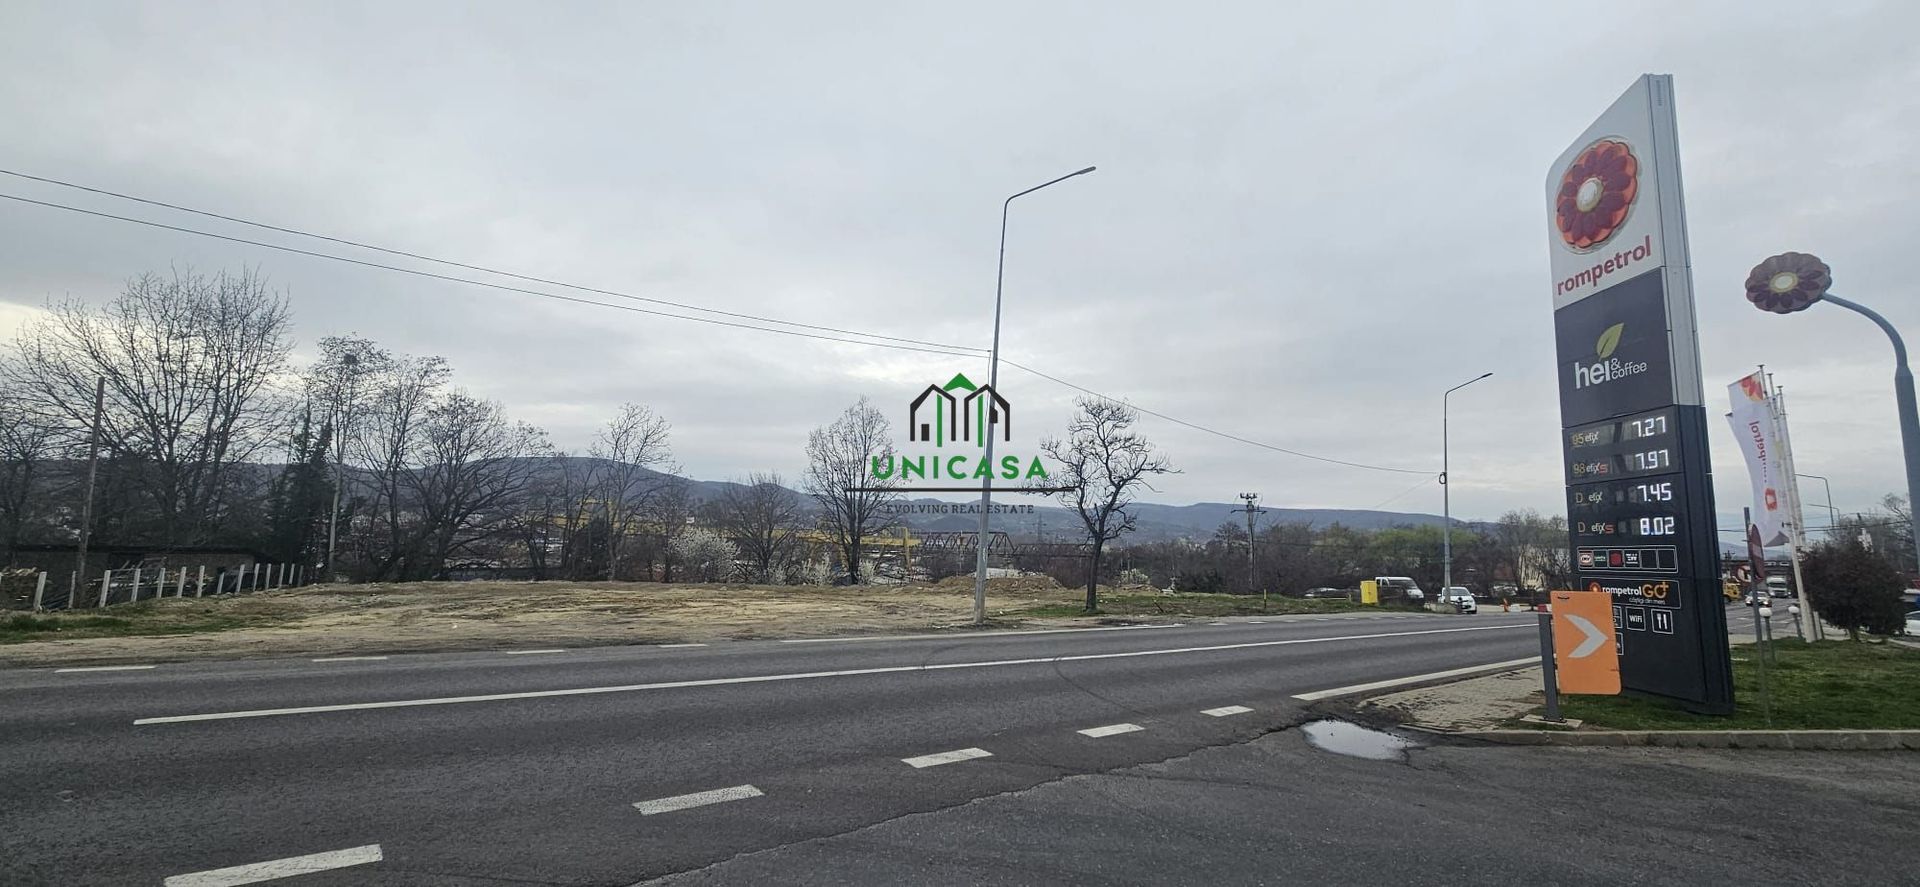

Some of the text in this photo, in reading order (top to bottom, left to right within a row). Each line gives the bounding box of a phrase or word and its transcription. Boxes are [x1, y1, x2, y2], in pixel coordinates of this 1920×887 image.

[1557, 234, 1652, 295] rompetrol
[1611, 360, 1648, 380] coffee
[1632, 416, 1667, 438] 7.27
[1635, 449, 1670, 470] 7.97
[1575, 492, 1584, 503] D
[1637, 482, 1673, 502] 7.45
[1577, 522, 1586, 533] D
[1639, 516, 1675, 536] 8.02
